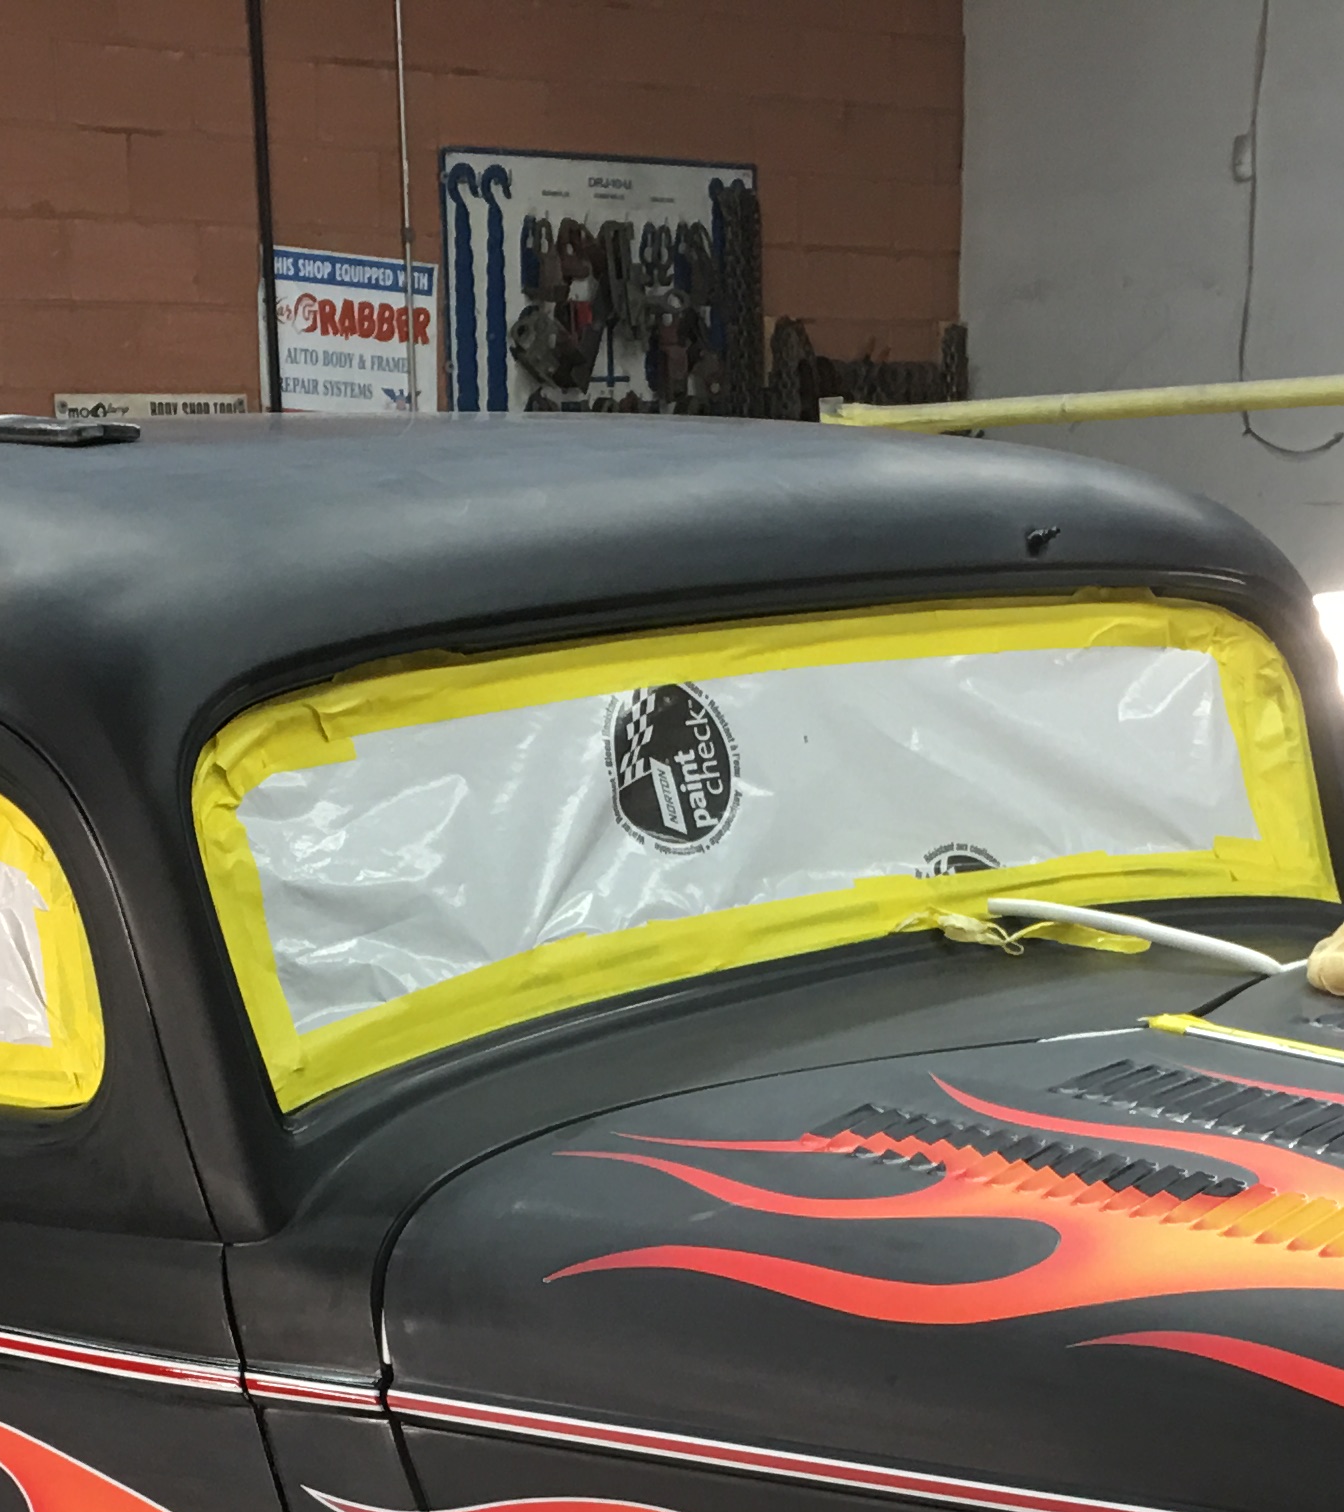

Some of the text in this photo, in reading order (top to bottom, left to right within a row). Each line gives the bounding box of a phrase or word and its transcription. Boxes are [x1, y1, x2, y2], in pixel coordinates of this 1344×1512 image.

[274, 256, 429, 291] HIS SHOP EQUIPPED WTH
[292, 293, 431, 346] GRABBER
[285, 347, 409, 374] AUTO BODY & FRAME
[281, 377, 374, 400] REPAIR SYSTEMS
[685, 707, 724, 796] check
[656, 767, 679, 825] NORTON
[674, 748, 720, 829] paint
